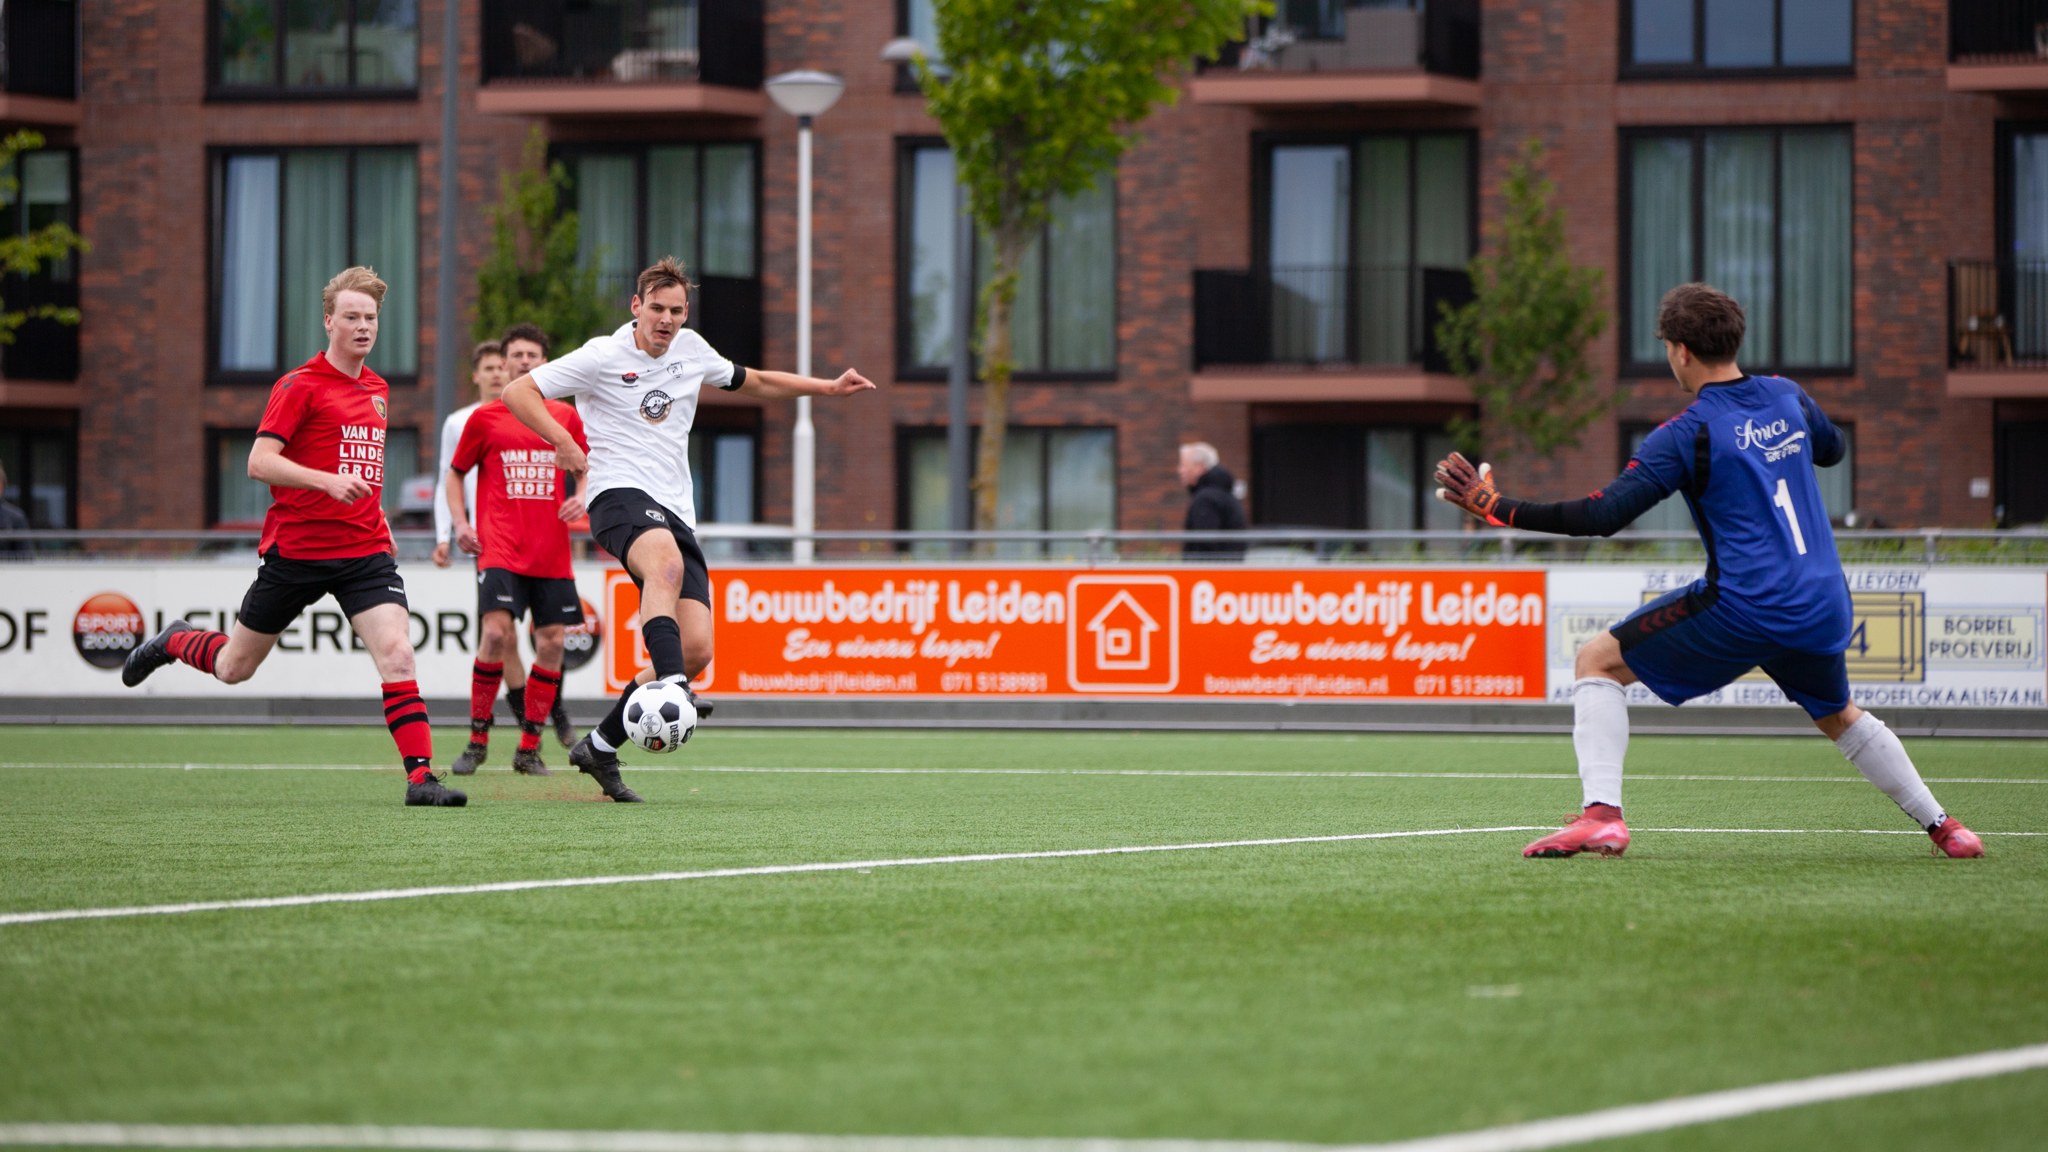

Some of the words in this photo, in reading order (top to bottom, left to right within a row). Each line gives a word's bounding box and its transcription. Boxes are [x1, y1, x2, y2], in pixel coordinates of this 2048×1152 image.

[341, 424, 368, 440] VAN
[339, 443, 384, 462] LINDE
[501, 449, 528, 463] VAN
[530, 449, 557, 464] DER
[338, 463, 384, 482] GROE
[503, 465, 556, 480] LINDEN
[1773, 478, 1807, 555] 1
[1856, 571, 1922, 590] LEYDEN
[725, 578, 940, 636] Bouwbedrijf
[947, 579, 1066, 625] Leiden
[1190, 579, 1413, 638] Bouwbedrijf
[1420, 580, 1543, 627] Leiden
[76, 613, 141, 634] SPORT
[1943, 617, 2016, 636] BORREL
[81, 631, 137, 651] 2000
[782, 627, 832, 662] Een
[835, 634, 916, 659] niveau
[919, 629, 1001, 668] hoger!
[1249, 629, 1300, 665] Een
[1305, 636, 1388, 662] niveau
[1391, 631, 1477, 671] hoger!
[1929, 641, 2033, 660] PROEVERIJ
[738, 670, 917, 695] bouwbedrijfleiden.nl
[940, 672, 972, 692] 071
[1203, 673, 1390, 698] bouwbedrijfleiden.nl
[1413, 674, 1446, 696] 071
